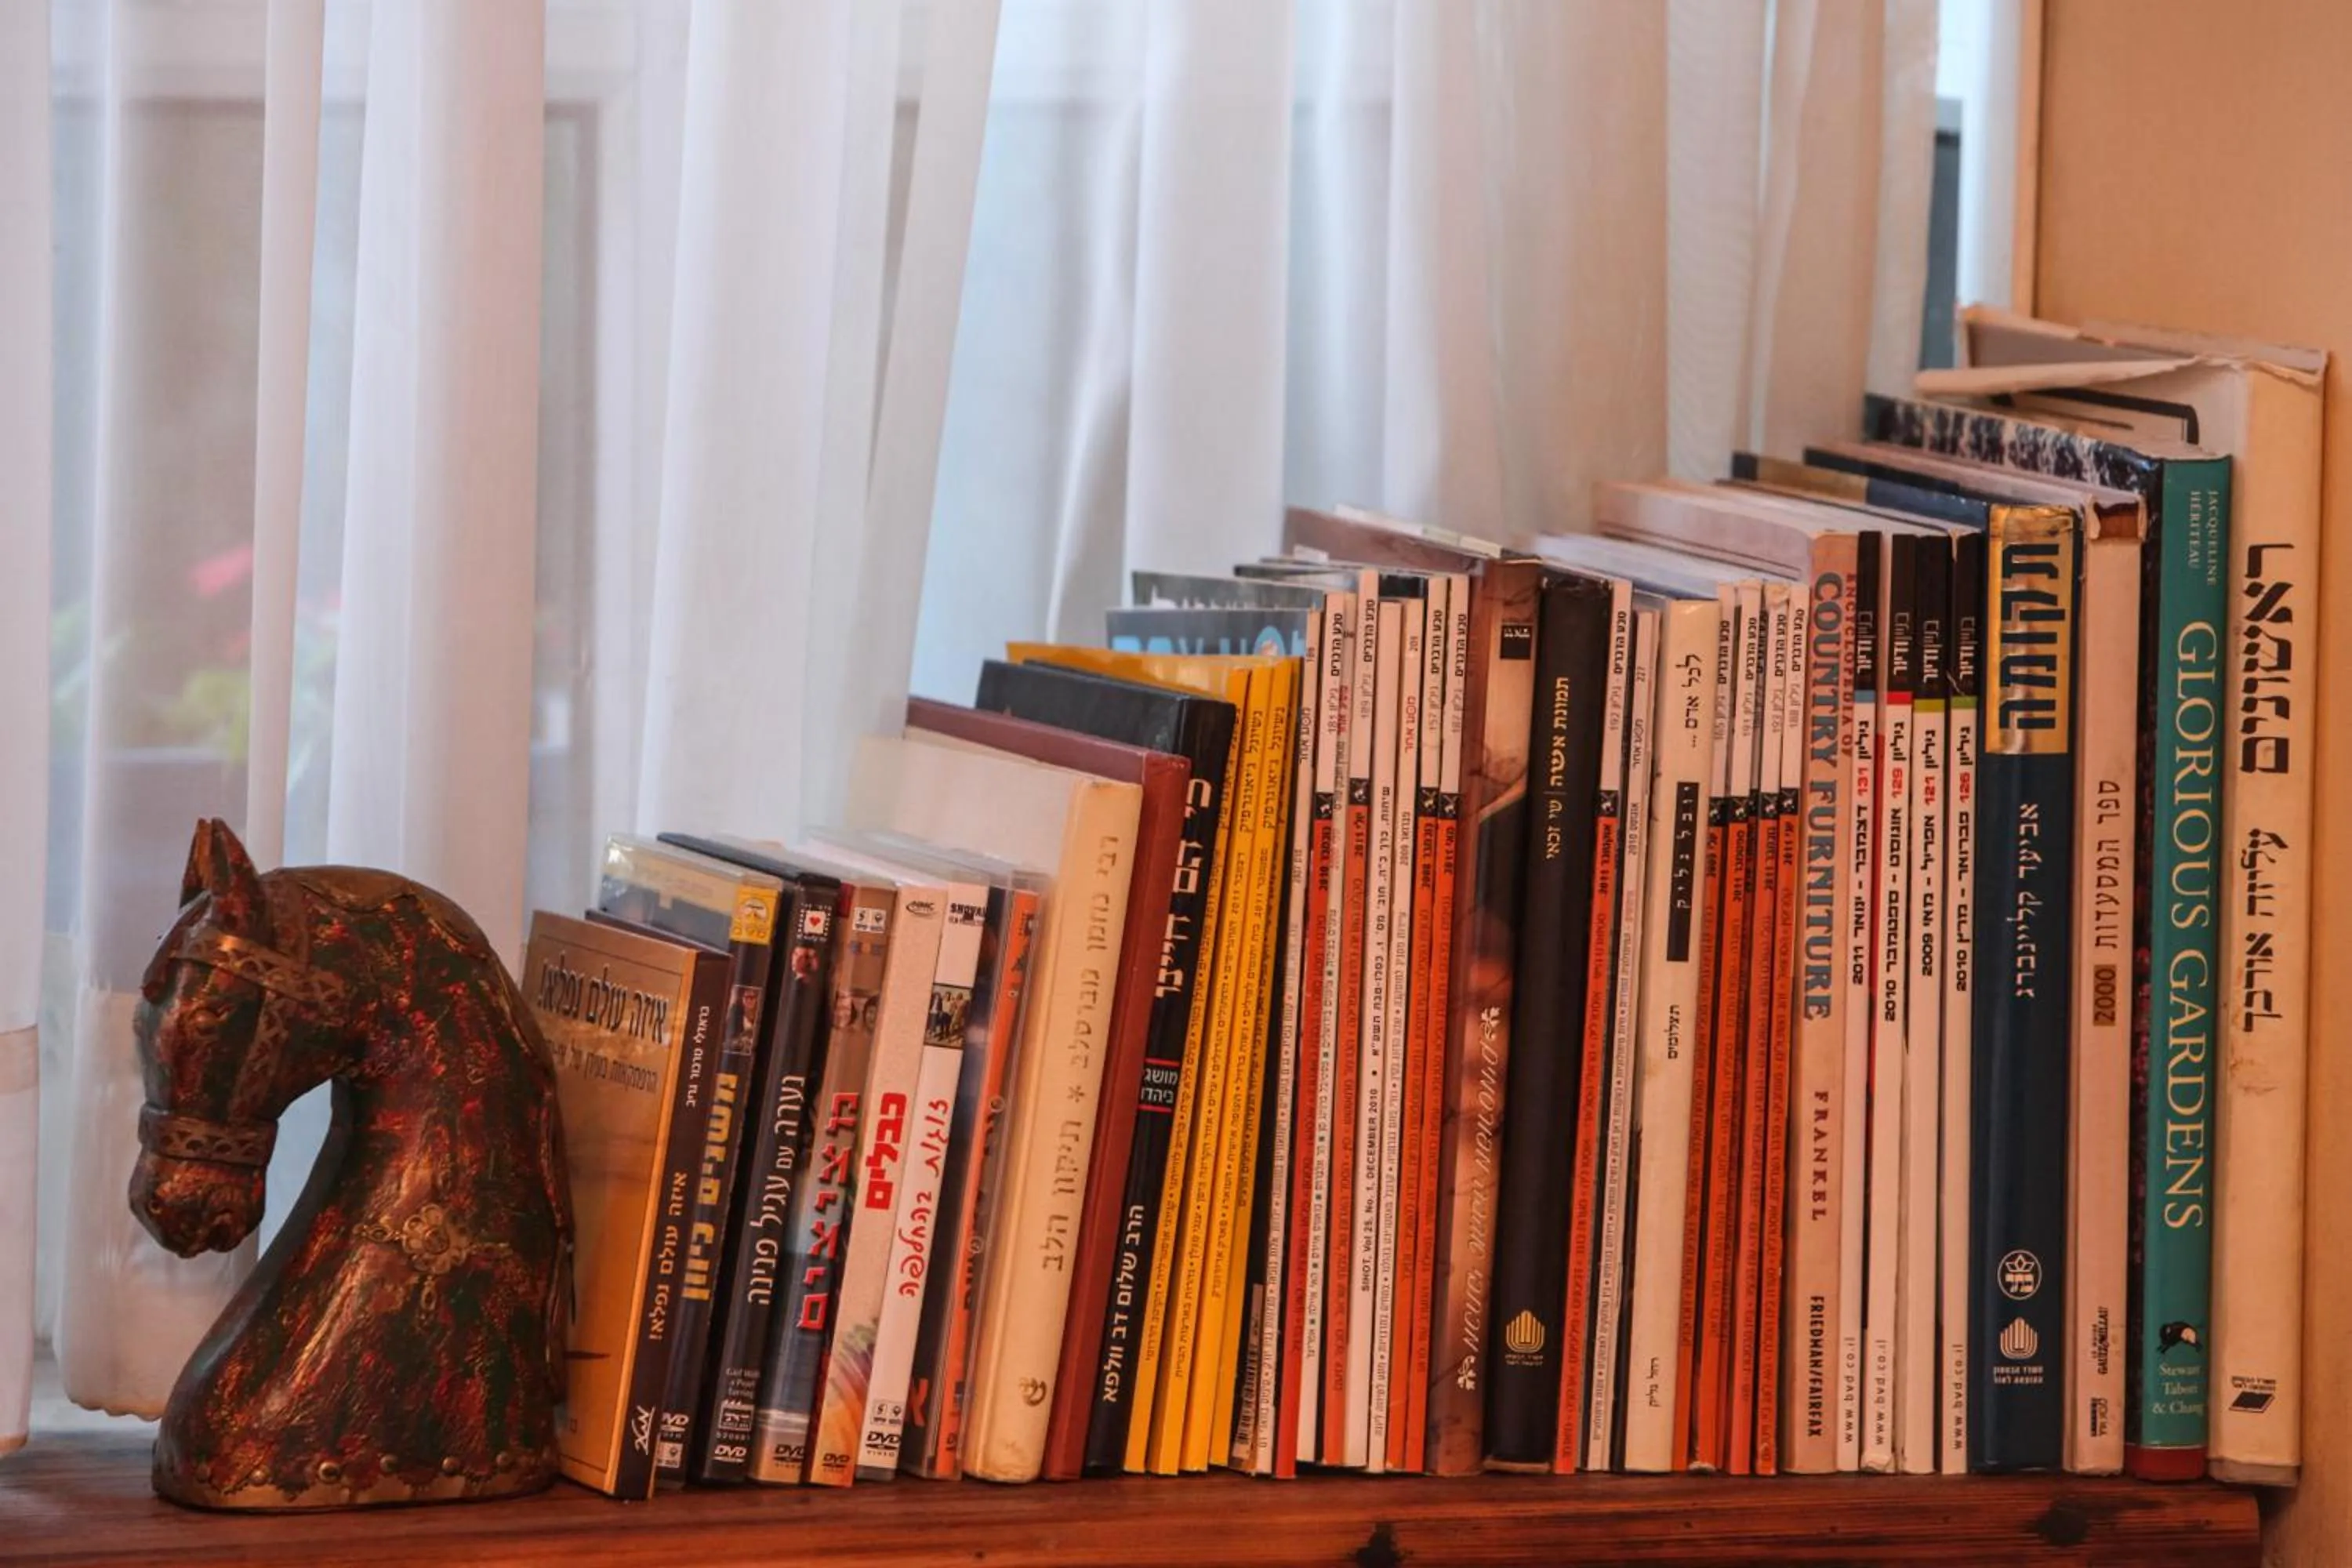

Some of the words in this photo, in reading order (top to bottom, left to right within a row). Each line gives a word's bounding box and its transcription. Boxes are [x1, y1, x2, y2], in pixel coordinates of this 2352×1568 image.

[2205, 491, 2219, 586] JACQUELINE
[1333, 612, 1342, 633] טבע
[1365, 598, 1375, 620] טבע
[1432, 609, 1443, 630] טבע
[1615, 611, 1626, 632] טבע
[1775, 613, 1786, 635] טבע
[1793, 608, 1803, 632] טבע
[1858, 610, 1875, 638] בניין
[1894, 613, 1911, 641] בניין
[1363, 623, 1374, 662] הדברים
[1719, 620, 1730, 641] טבע
[1842, 574, 1856, 726] ENCYCLOPEDIA
[1925, 619, 1942, 648] בניין
[1998, 543, 2065, 729] תקומה
[1330, 637, 1341, 676] הדברים
[1430, 635, 1441, 673] הדברים
[1612, 636, 1624, 673] הדברים
[1675, 653, 1700, 687] לכל
[1717, 645, 1729, 684] הדברים
[1773, 638, 1784, 677] הדברים
[1791, 633, 1802, 672] הדברים
[1811, 572, 1843, 768] COUNTRY
[1857, 640, 1872, 673] ודיור
[1893, 641, 1909, 675] ודיור
[1923, 648, 1939, 682] ודיור
[2238, 543, 2295, 774] ראשונים
[1636, 666, 1646, 682] 227
[1553, 677, 1572, 728] תמונת
[1682, 695, 1700, 728] אדם
[1244, 710, 1262, 753] נשיונל
[1268, 706, 1284, 750] נשיונל
[1405, 728, 1414, 752] אחר
[1841, 734, 1853, 757] OF
[1856, 720, 1872, 760] גיליון
[1889, 721, 1906, 761] גיליון
[1922, 729, 1939, 769] גיליון
[1956, 726, 1973, 766] גיליון
[1549, 735, 1568, 786] אשה
[1631, 746, 1641, 769] אחר
[2170, 622, 2218, 929] GLORIOUS
[1183, 779, 1211, 817] כי
[1237, 762, 1261, 832] ג'יאוגרפיק
[1261, 759, 1283, 829] ג'יאוגרפיק
[1857, 766, 1870, 795] 131
[1891, 767, 1904, 799] 129
[1923, 775, 1936, 806] 121
[1959, 771, 1970, 803] 126
[1548, 800, 1564, 818] שי
[2096, 781, 2120, 825] ספר
[1094, 836, 1118, 876] רבי
[1379, 831, 1388, 850] כרך
[1544, 826, 1562, 858] זכאי
[1628, 833, 1637, 855] 2010
[1855, 804, 1867, 873] דצמבר
[1889, 808, 1902, 866] אוגוסט
[1920, 815, 1934, 869] אפריל
[1957, 811, 1969, 881] פברואר
[2019, 804, 2042, 878] אביעד
[1171, 840, 1205, 892] הם
[2241, 830, 2288, 918] עליזה
[1804, 779, 1837, 1020] FURNITURE
[1922, 893, 1933, 927] מאי
[2094, 840, 2120, 949] המסעדות
[1084, 892, 1114, 951] נחמן
[1854, 896, 1865, 938] ינואר
[1886, 890, 1898, 973] ספטמבר
[1956, 904, 1970, 943] מרץ
[1155, 913, 1192, 996] חיינו
[1921, 933, 1933, 977] 2009
[2007, 891, 2042, 997] קליינברג
[1852, 946, 1864, 985] 2011
[1955, 949, 1968, 992] 2010
[2243, 935, 2283, 1034] אורבך
[586, 963, 628, 1033] עולם
[1884, 980, 1896, 1022] 2010
[2094, 968, 2115, 1022] 2000
[629, 990, 669, 1045] איזה
[1065, 968, 1103, 1069] מברסלב
[1662, 1004, 1681, 1059] תצלומים
[689, 1048, 703, 1079] טרבור
[772, 1074, 807, 1135] נערה
[1369, 1088, 1377, 1113] 2010
[2164, 949, 2209, 1229] GARDENS
[696, 1073, 738, 1204] משנים
[775, 1145, 794, 1168] עם
[858, 1092, 907, 1210] כבלים
[920, 1099, 949, 1178] זוגות
[1049, 1120, 1084, 1194] תיקון
[1366, 1117, 1376, 1178] DECEMBER
[1812, 1091, 1829, 1221] FRANKEL
[666, 1172, 686, 1215] איזה
[750, 1175, 792, 1226] עגיל
[795, 1092, 858, 1329] מציצים
[1037, 1214, 1069, 1271] הלב
[1123, 1205, 1144, 1245] הרב
[1363, 1235, 1371, 1252] Vol
[654, 1225, 679, 1274] עולם
[681, 1221, 720, 1301] כיוון
[744, 1238, 780, 1305] פנינה
[1112, 1253, 1137, 1305] שלום
[644, 1283, 670, 1340] נפלא!
[1109, 1312, 1127, 1338] דב
[1098, 1345, 1124, 1402] וולפא
[1646, 1357, 1661, 1379] רחל
[1808, 1295, 1824, 1437] FRIEDMAN/FAIRFAX
[1645, 1383, 1660, 1407] גליק
[715, 1445, 747, 1457] DVD
[867, 1431, 901, 1443] DVD
[823, 1454, 850, 1463] DVD
